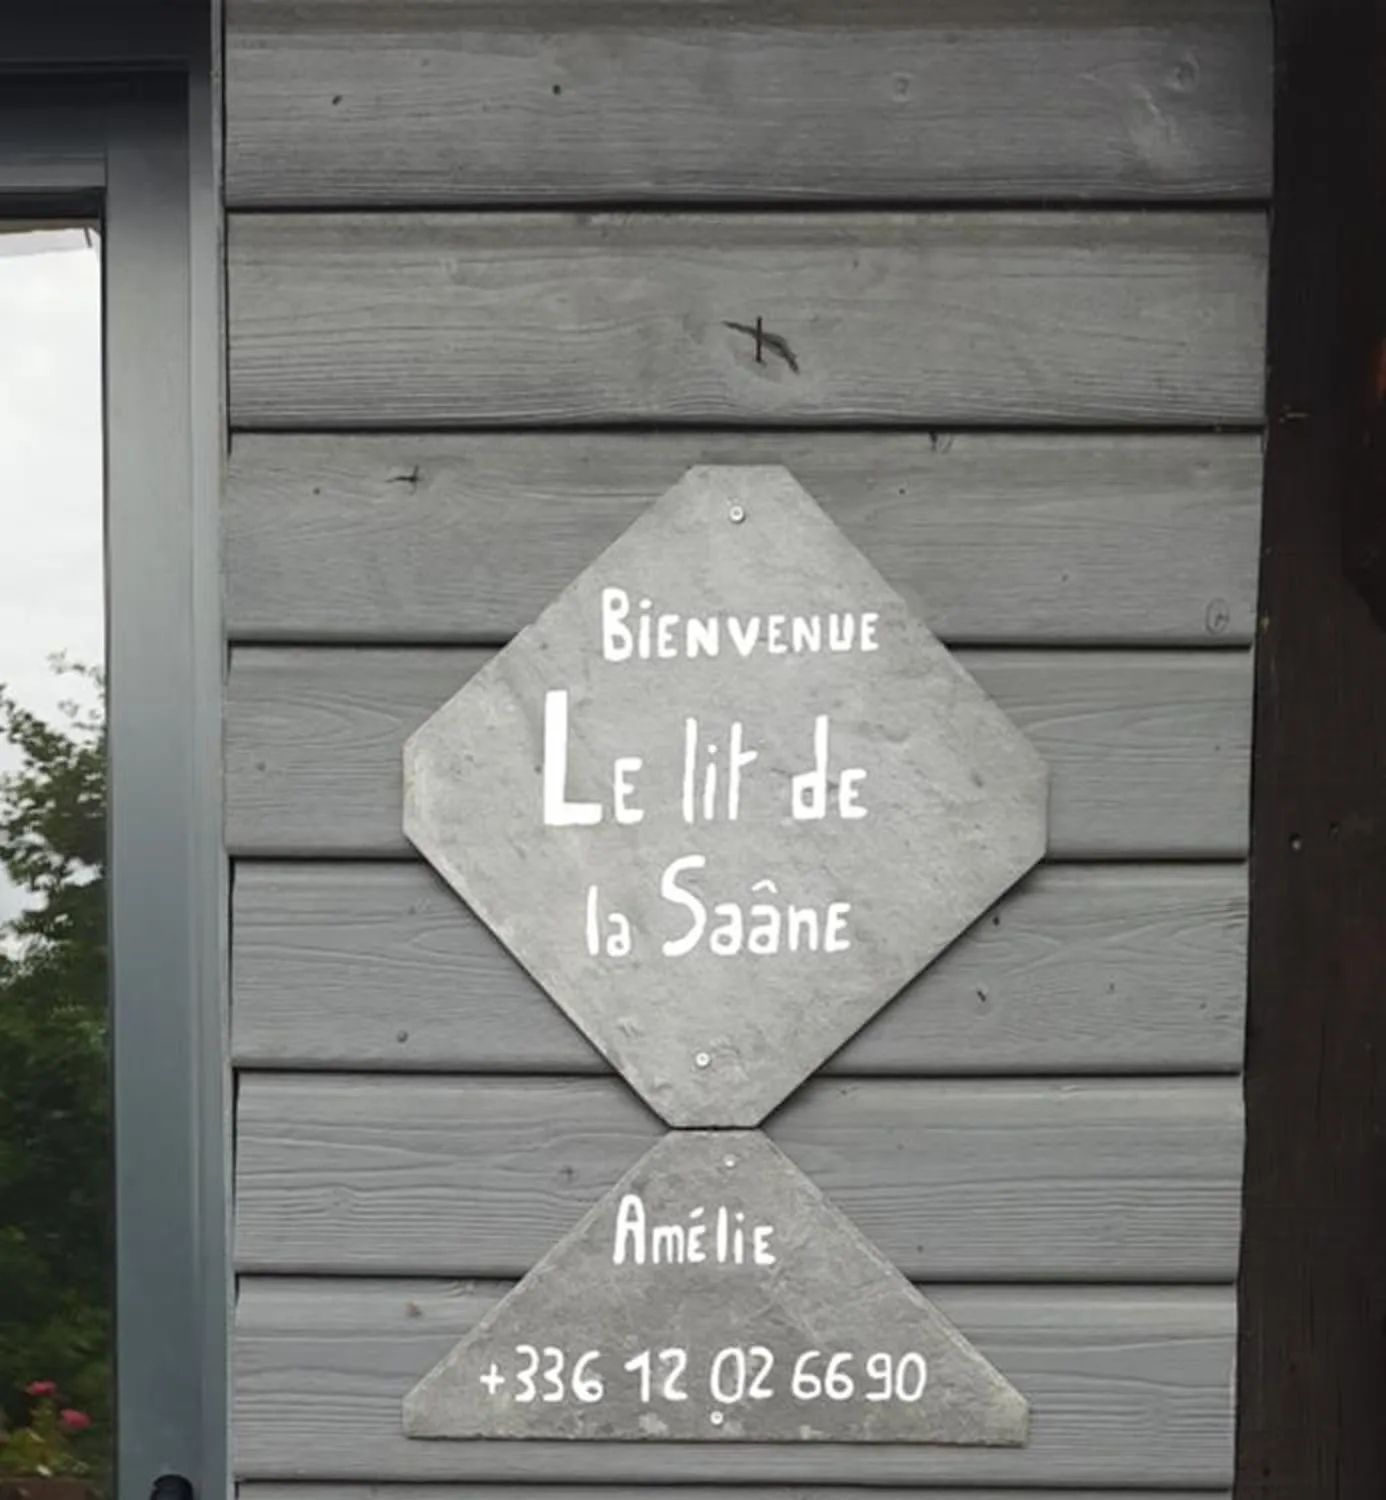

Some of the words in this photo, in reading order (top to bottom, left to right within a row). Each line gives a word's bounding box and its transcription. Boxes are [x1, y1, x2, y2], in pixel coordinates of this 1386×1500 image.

[680, 715, 760, 825] lit
[584, 883, 633, 959] la
[478, 1343, 605, 1408] +336
[622, 1346, 690, 1404] 12
[708, 1344, 775, 1406] 02
